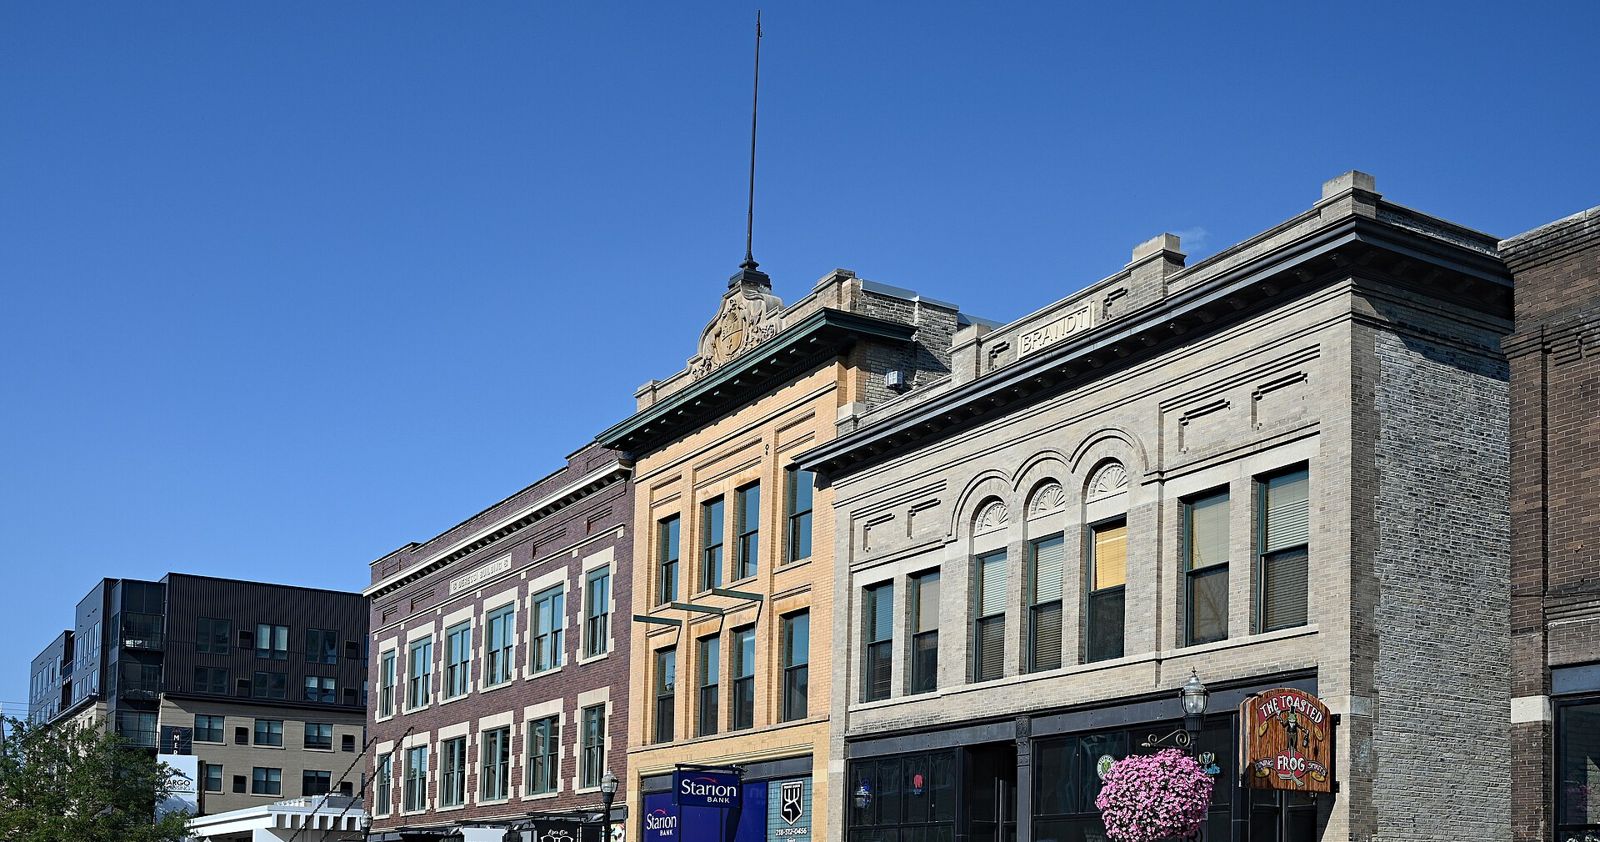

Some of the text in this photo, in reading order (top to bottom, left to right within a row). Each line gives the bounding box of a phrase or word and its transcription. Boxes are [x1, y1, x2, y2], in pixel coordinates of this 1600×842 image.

[1022, 309, 1088, 354] BRANDT
[1260, 695, 1323, 724] THE TOASTED
[1277, 755, 1306, 772] FROG
[681, 779, 737, 797] Starion
[706, 796, 730, 804] BANK
[646, 813, 677, 830] Starion
[659, 829, 674, 837] BANK
